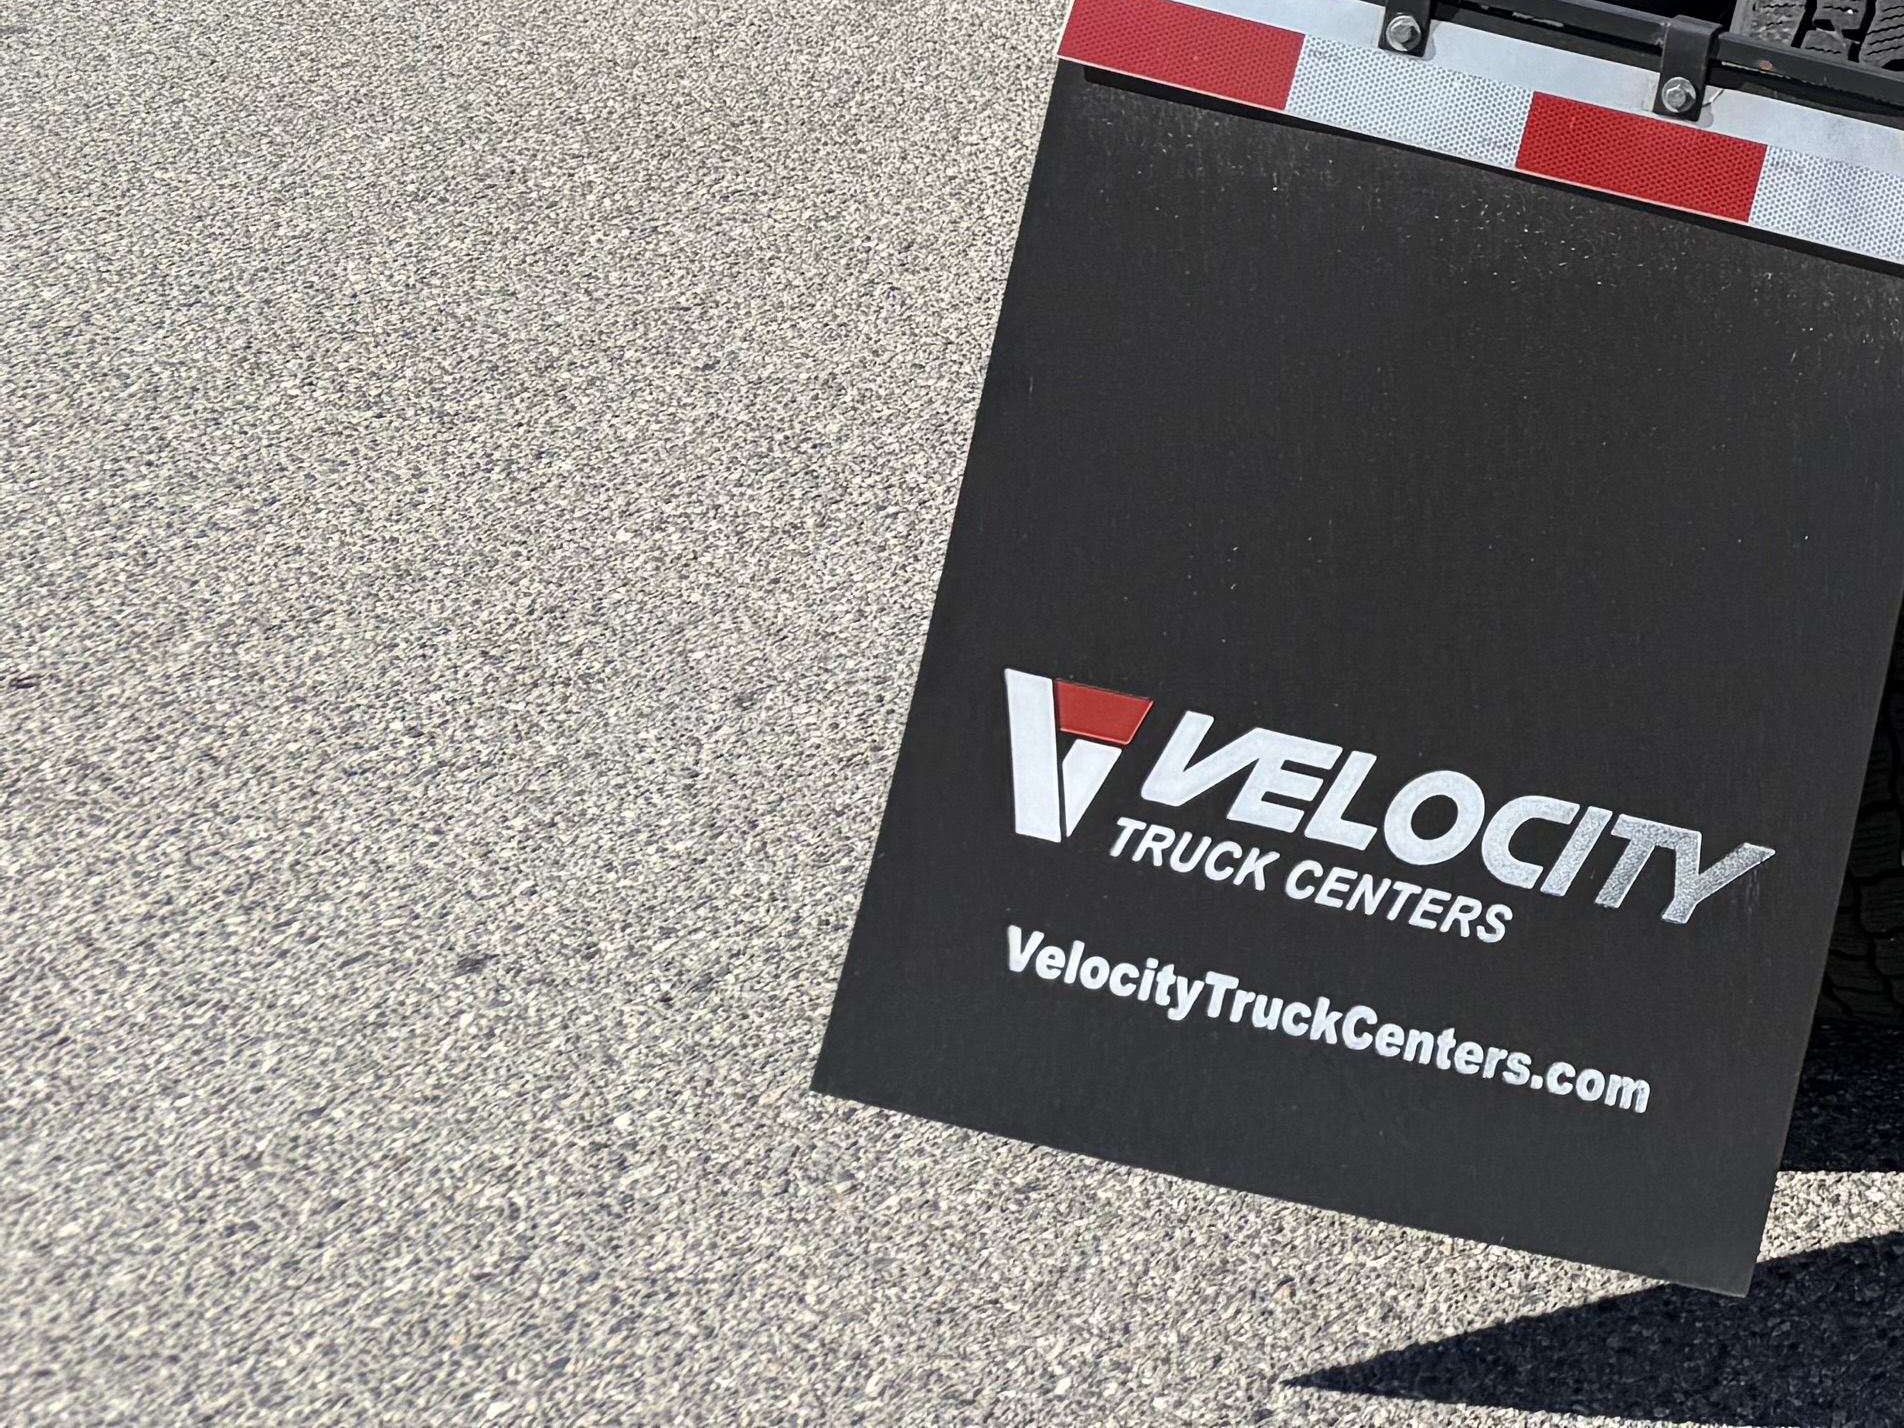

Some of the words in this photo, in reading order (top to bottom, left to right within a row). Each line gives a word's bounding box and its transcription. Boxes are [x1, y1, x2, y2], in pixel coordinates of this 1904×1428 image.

[1109, 817, 1281, 892] TRUCK
[1284, 859, 1514, 944] CENTERS
[1140, 710, 1776, 924] VELOCITY
[1007, 924, 1651, 1114] VelocityTruckCenters.com
